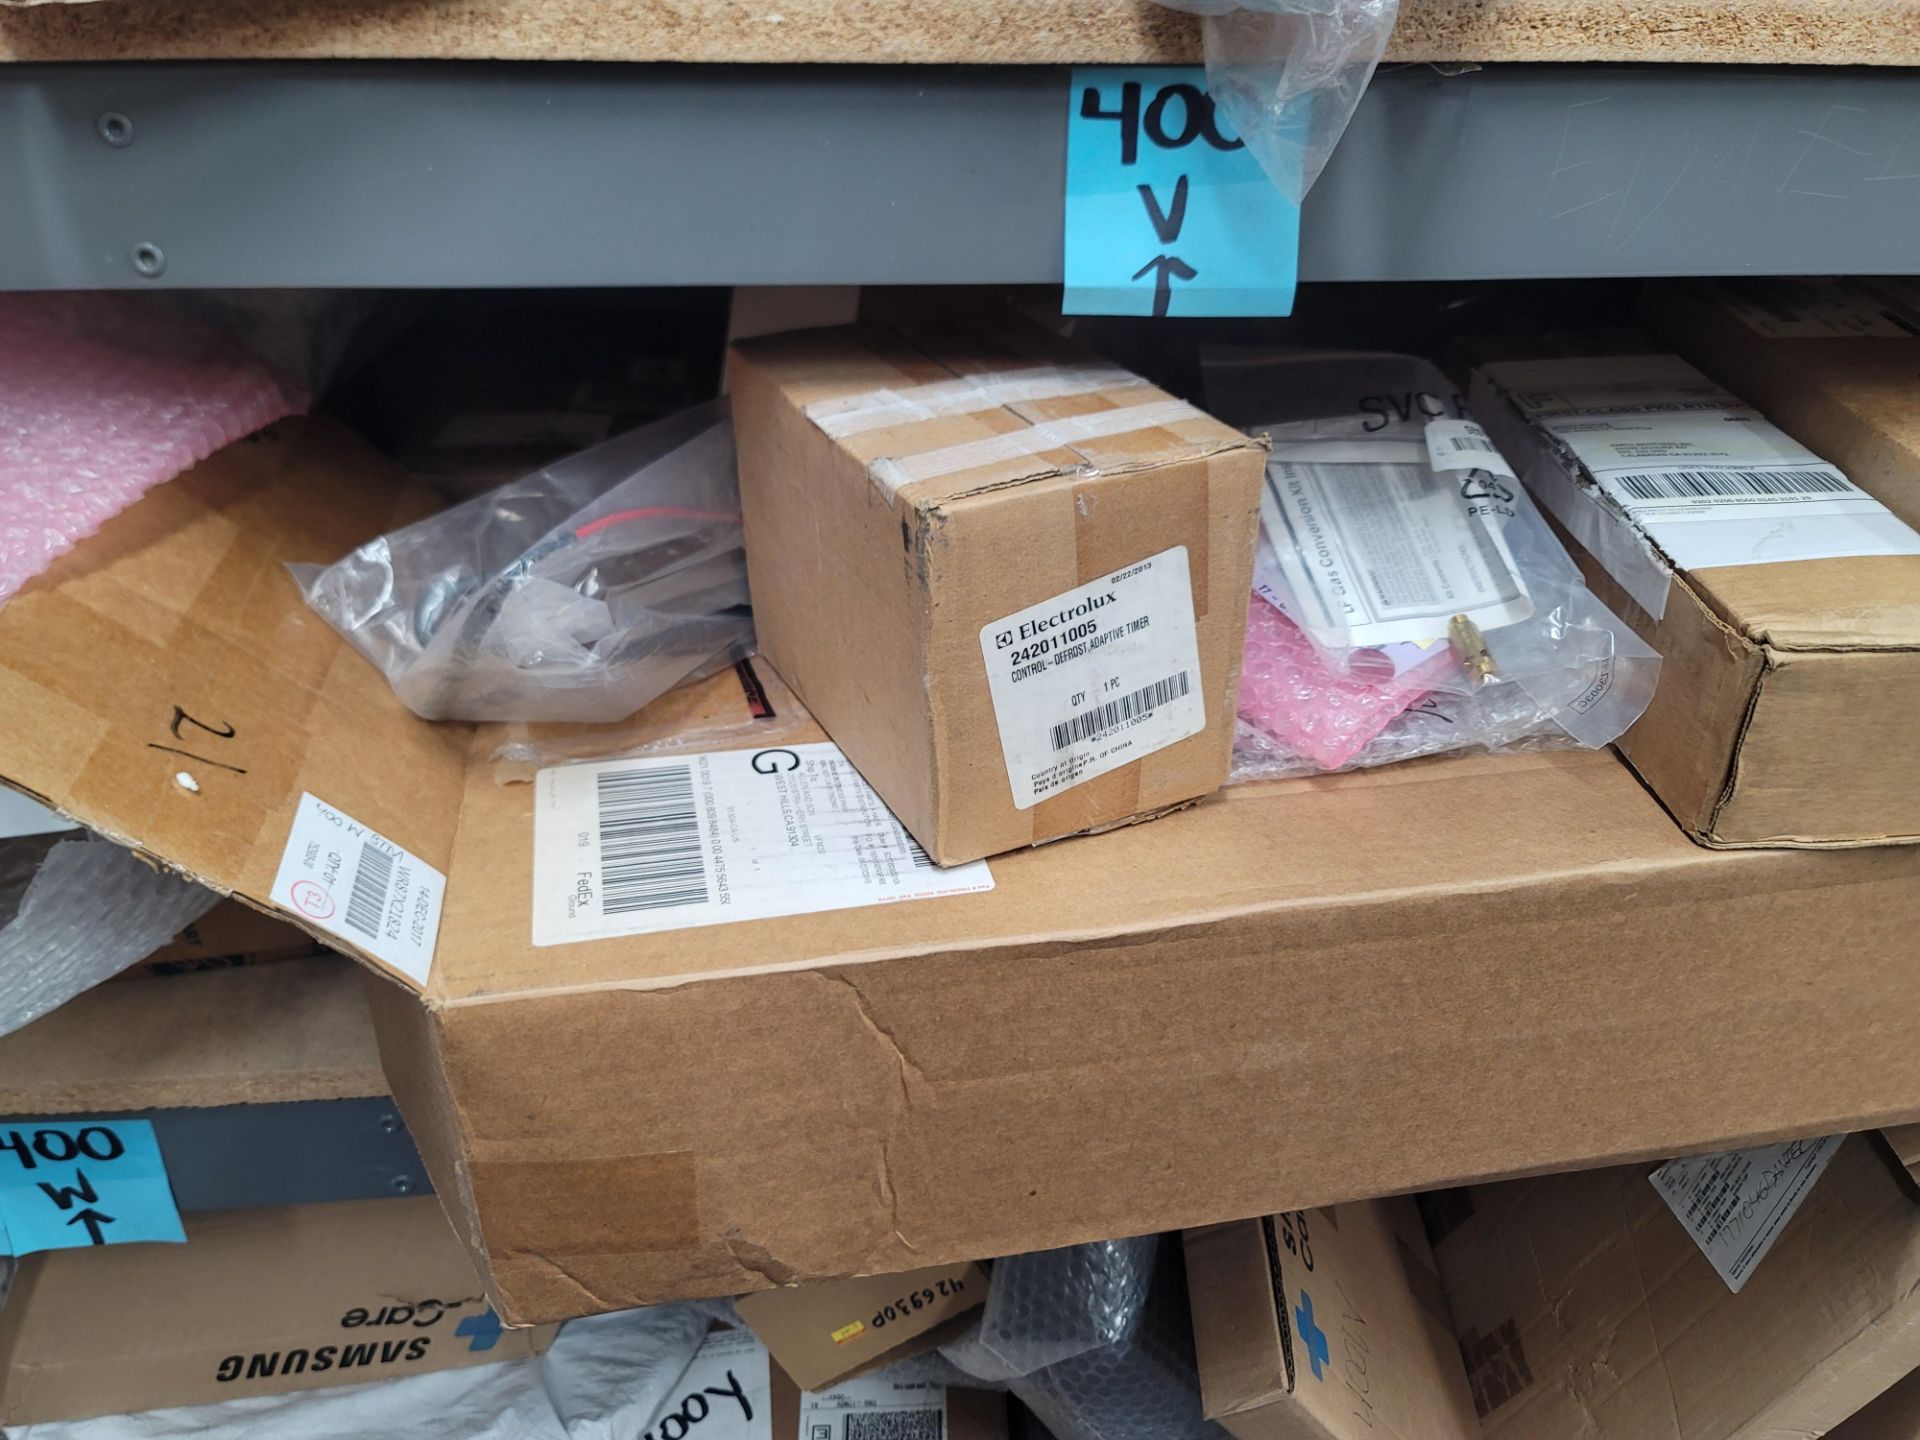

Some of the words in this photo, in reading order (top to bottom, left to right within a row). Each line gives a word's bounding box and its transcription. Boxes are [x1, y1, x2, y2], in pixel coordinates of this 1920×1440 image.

[1136, 174, 1188, 244] V
[1295, 496, 1334, 569] Conversion
[1111, 562, 1152, 584] 02/22/2013
[1019, 590, 1117, 641] Electrolux
[1126, 616, 1150, 638] TIMER
[1011, 620, 1098, 666] 242011005
[1071, 691, 1086, 707] QTY
[1110, 676, 1120, 690] PC
[751, 748, 801, 775] G
[1111, 740, 1133, 754] CHINA
[1032, 764, 1058, 780] Country
[773, 773, 787, 793] WEST
[785, 826, 799, 846] 91304
[713, 855, 725, 872] 4475
[716, 873, 729, 891] 5643
[576, 870, 593, 908] FedEx
[0, 1127, 126, 1169] 400
[339, 1299, 445, 1335] Care
[214, 1336, 433, 1383] SAMSUNG
[643, 1369, 754, 1440] 00Y
